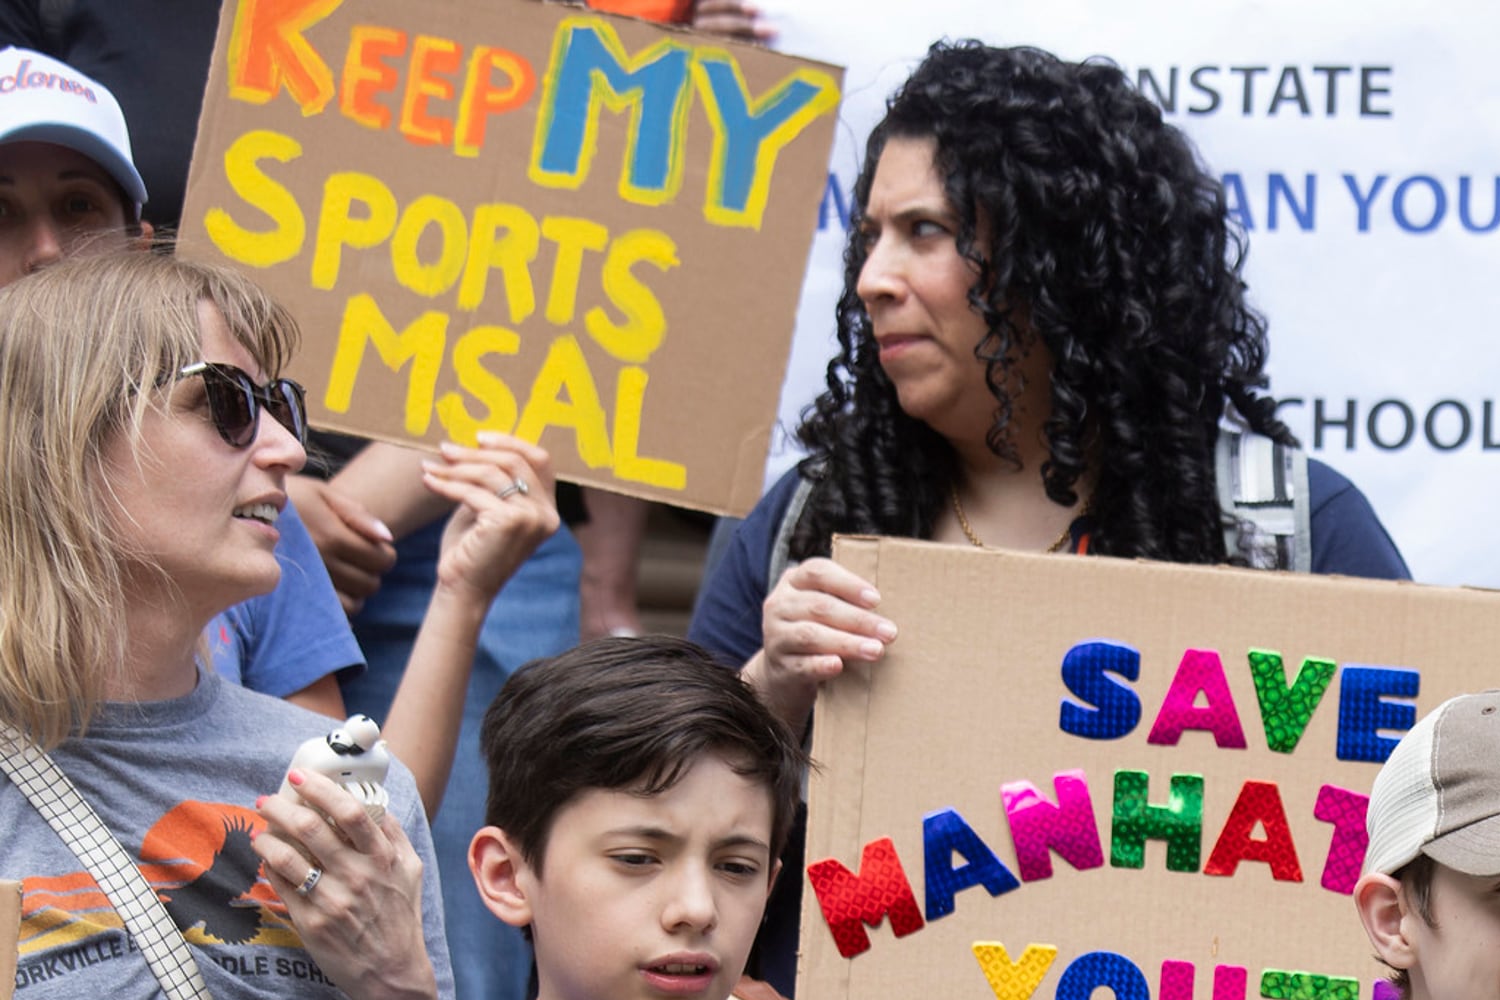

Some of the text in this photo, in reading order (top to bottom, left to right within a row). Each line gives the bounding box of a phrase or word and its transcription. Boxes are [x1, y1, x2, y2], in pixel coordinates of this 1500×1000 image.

[229, 0, 842, 231] KEEP MY
[1136, 66, 1393, 116] NSTATE
[205, 129, 681, 364] SPORTS
[324, 292, 688, 491] MSAL
[1058, 637, 1421, 765] SAVE
[806, 768, 1371, 961] MANHAT
[16, 936, 124, 990] ORKVILLE
[276, 957, 337, 987] SCH
